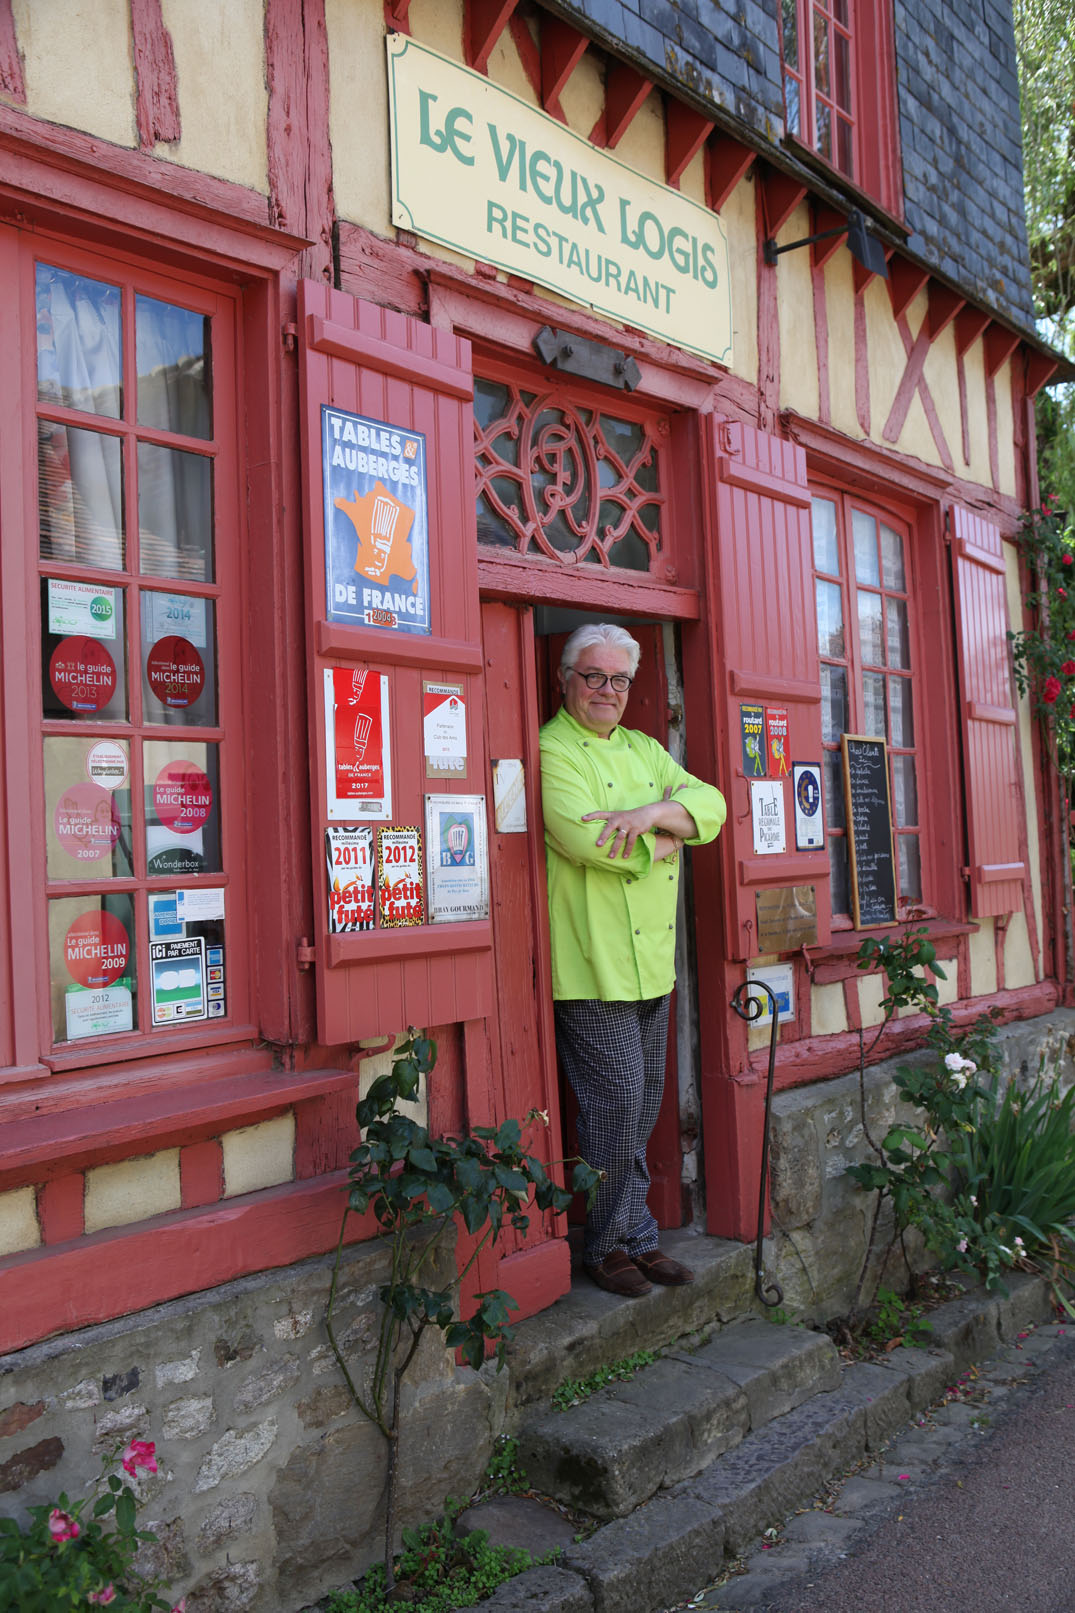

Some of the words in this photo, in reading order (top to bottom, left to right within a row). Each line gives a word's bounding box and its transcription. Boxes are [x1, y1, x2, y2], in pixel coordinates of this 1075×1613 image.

[418, 87, 475, 166] LE
[487, 122, 606, 235] VIEUX
[618, 196, 718, 290] LOGIS
[487, 199, 676, 314] RESTAURANT
[331, 416, 402, 456] TABLES
[332, 445, 419, 486] AUBERGES
[335, 583, 357, 605] DE
[362, 587, 424, 616] FRANCE
[91, 604, 111, 615] 2015
[166, 607, 191, 620] 2014
[373, 609, 392, 623] 2004
[77, 661, 86, 671] le
[87, 663, 112, 674] guide
[170, 662, 177, 671] le
[178, 664, 200, 672] guide
[55, 671, 112, 686] MICHELIN
[151, 672, 200, 683] MICHELIN
[71, 685, 97, 698] 2013
[165, 683, 188, 694] 2014
[743, 716, 762, 724] routard
[744, 724, 762, 733] 2007
[770, 727, 787, 736] 2008
[338, 763, 353, 771] tables
[359, 763, 380, 772] auberges
[156, 794, 209, 805] MICHELIN
[180, 807, 206, 817] 2008
[59, 816, 68, 824] Le
[70, 816, 92, 824] guide
[59, 825, 117, 835] MICHELIN
[332, 833, 367, 841] RECOMMANDÉ
[77, 850, 100, 858] 2007
[334, 846, 366, 865] 2011
[385, 845, 416, 863] 2012
[443, 852, 451, 865] B
[465, 852, 474, 865] G
[153, 858, 199, 869] Wonderbox
[330, 883, 374, 910] petit
[381, 881, 422, 907] petit
[337, 905, 374, 924] futé
[388, 901, 422, 920] futé
[67, 936, 77, 946] Le
[78, 936, 100, 947] guide
[170, 941, 198, 950] PAIEMENT
[68, 943, 127, 960] MICHELIN
[167, 949, 179, 957] PAR
[181, 947, 200, 956] CARTE
[101, 957, 125, 969] 2009
[91, 994, 110, 1004] 2012
